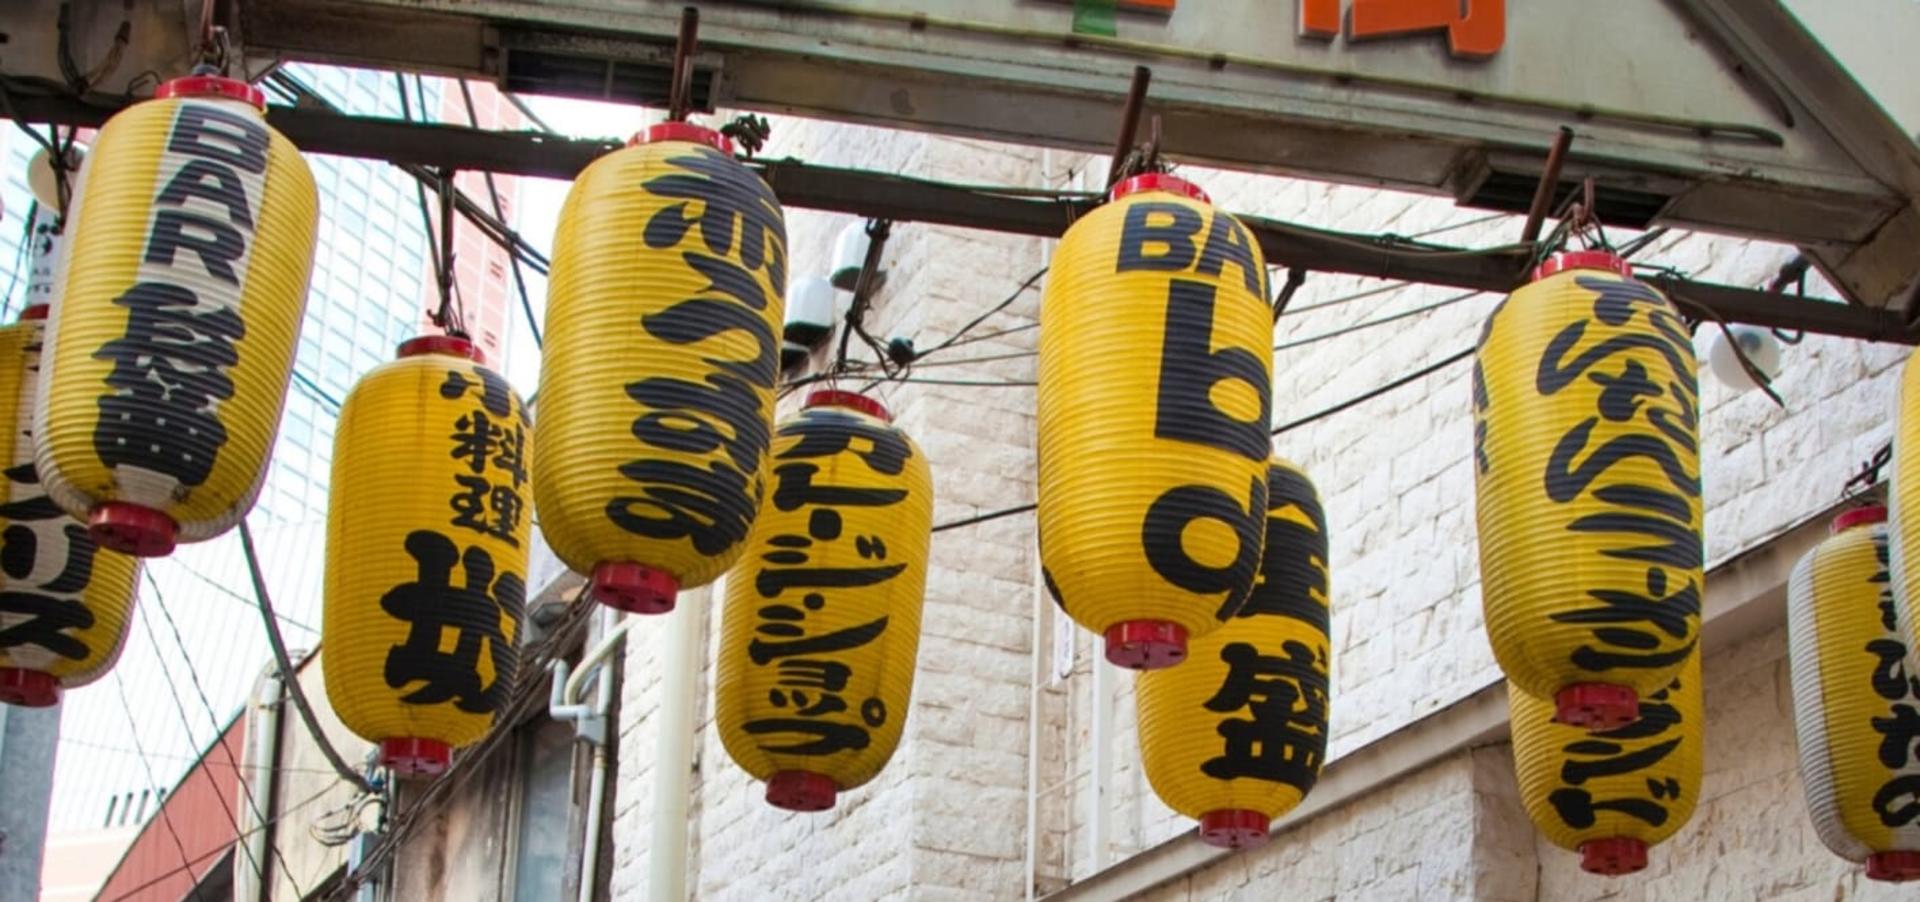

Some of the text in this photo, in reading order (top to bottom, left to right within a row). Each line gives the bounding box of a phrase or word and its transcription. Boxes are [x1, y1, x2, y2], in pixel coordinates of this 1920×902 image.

[144, 104, 272, 286] BAR
[440, 366, 531, 549] 小料理
